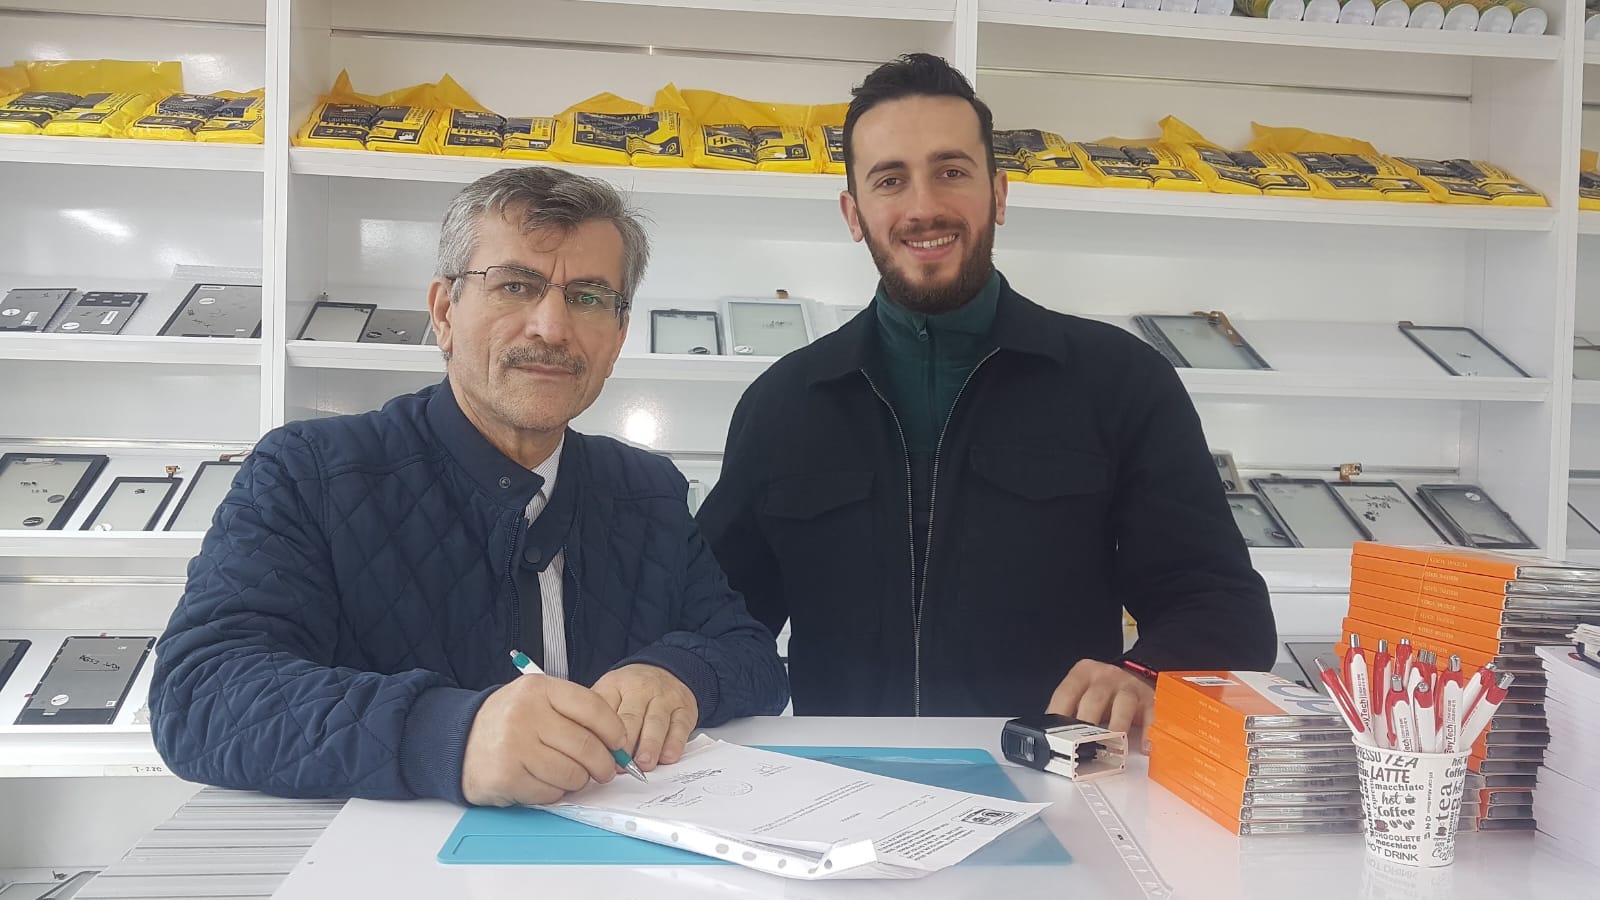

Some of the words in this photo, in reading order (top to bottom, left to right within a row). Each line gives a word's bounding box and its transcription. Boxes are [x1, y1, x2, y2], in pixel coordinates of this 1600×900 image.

[1370, 765, 1411, 783] LATTE
[1374, 783, 1425, 792] macchiato
[1435, 781, 1453, 822] tea
[1377, 805, 1416, 818] Coffee
[1375, 838, 1417, 851] macchiato
[1384, 848, 1420, 862] DRINK
